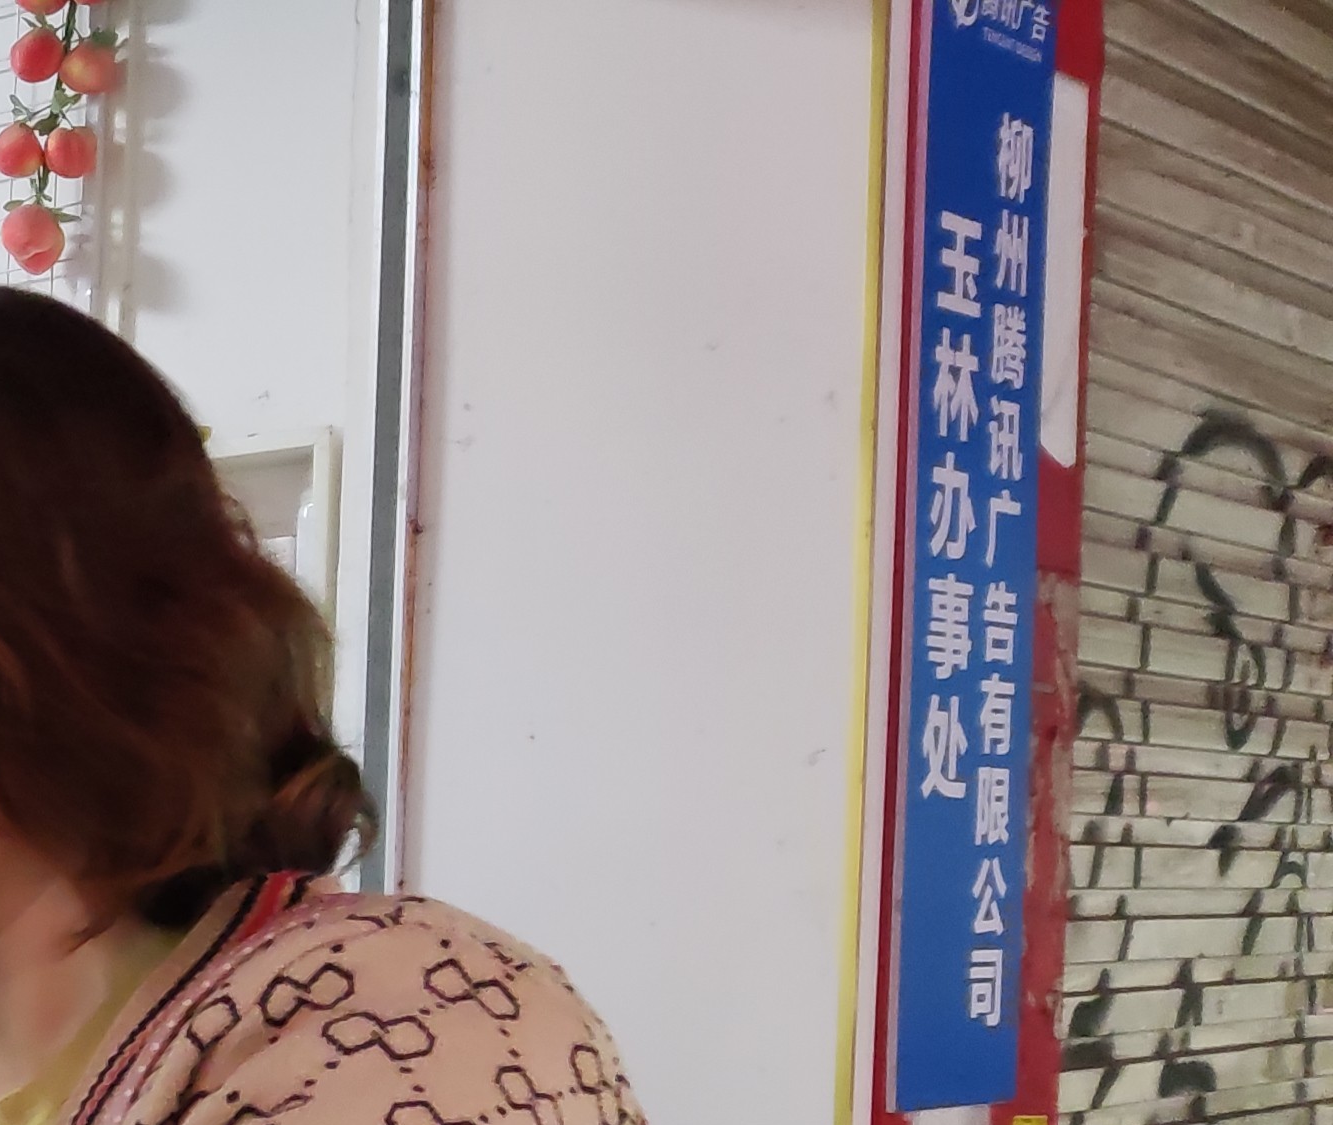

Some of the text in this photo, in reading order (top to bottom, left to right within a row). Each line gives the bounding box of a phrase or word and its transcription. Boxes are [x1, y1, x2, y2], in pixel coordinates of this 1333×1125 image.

[920, 209, 983, 800] 玉林办事处
[969, 112, 1034, 1027] 柳州腾讯广告有限公司
